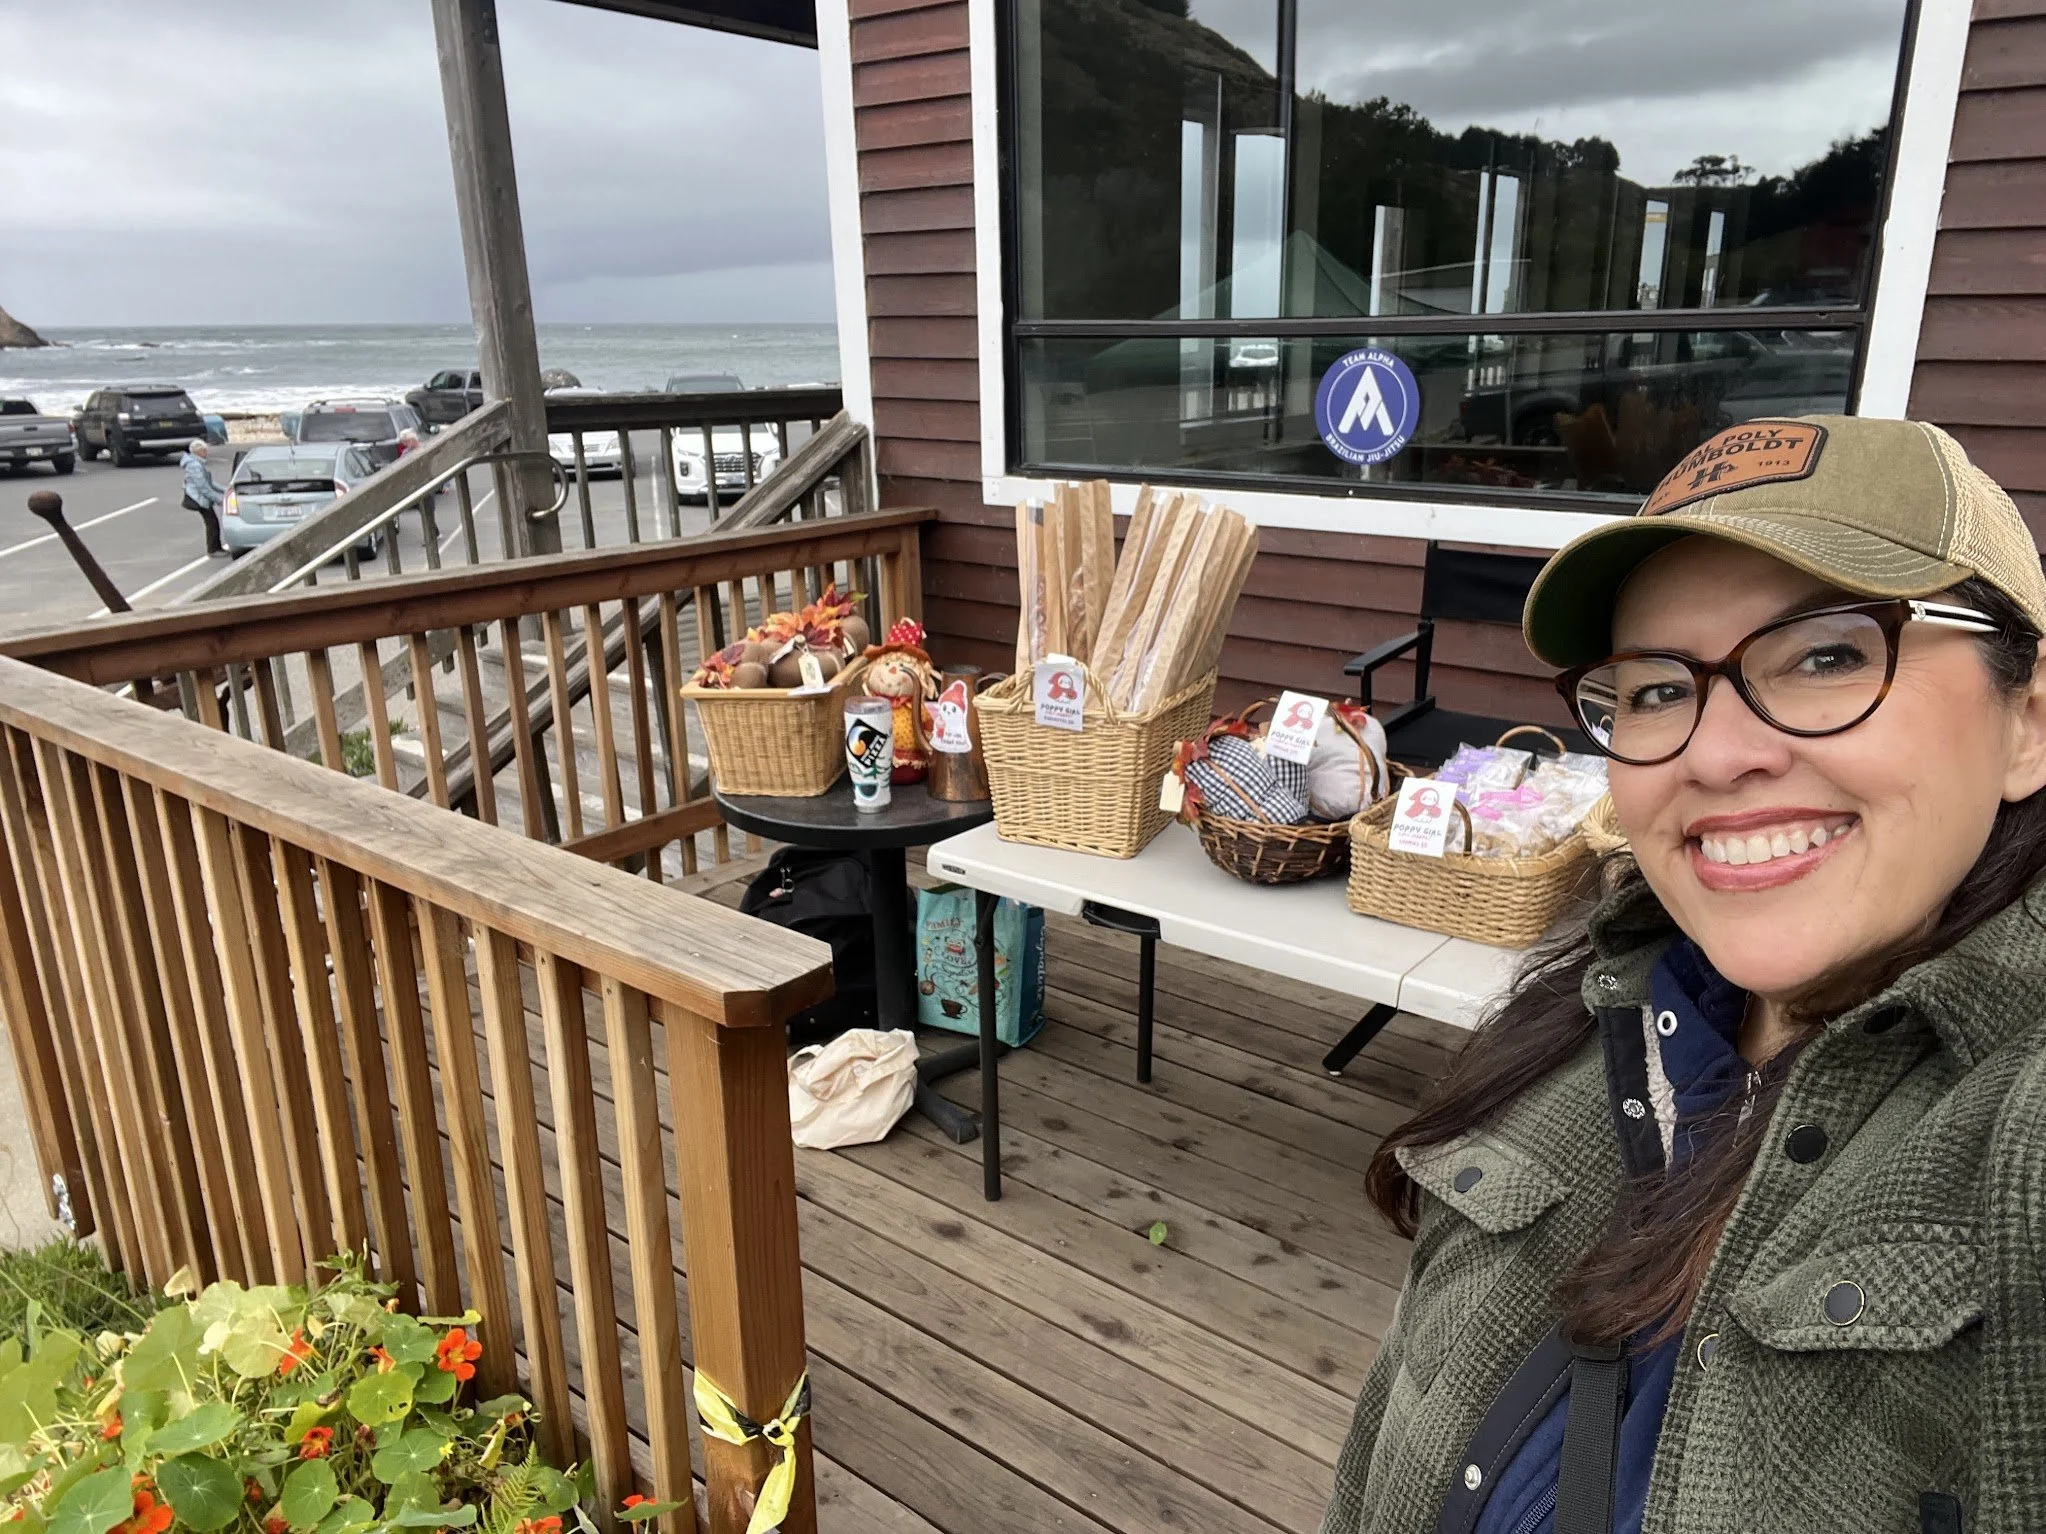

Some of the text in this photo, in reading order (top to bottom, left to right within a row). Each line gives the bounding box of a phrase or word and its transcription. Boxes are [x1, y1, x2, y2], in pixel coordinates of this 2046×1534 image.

[1342, 352, 1394, 368] TEAM ALPHA
[1723, 429, 1783, 444] POLY
[1325, 433, 1405, 462] BRAZILIAN JIU-JITSU
[1657, 439, 1804, 492] HUMBOLDT
[1041, 703, 1063, 712] POPPY
[1065, 707, 1080, 715] GIRL
[1271, 731, 1294, 741] POPPY
[1295, 736, 1311, 746] GIRL
[864, 737, 887, 766] PIZZA
[1393, 823, 1421, 833] POPPY
[1423, 827, 1442, 837] GIRL
